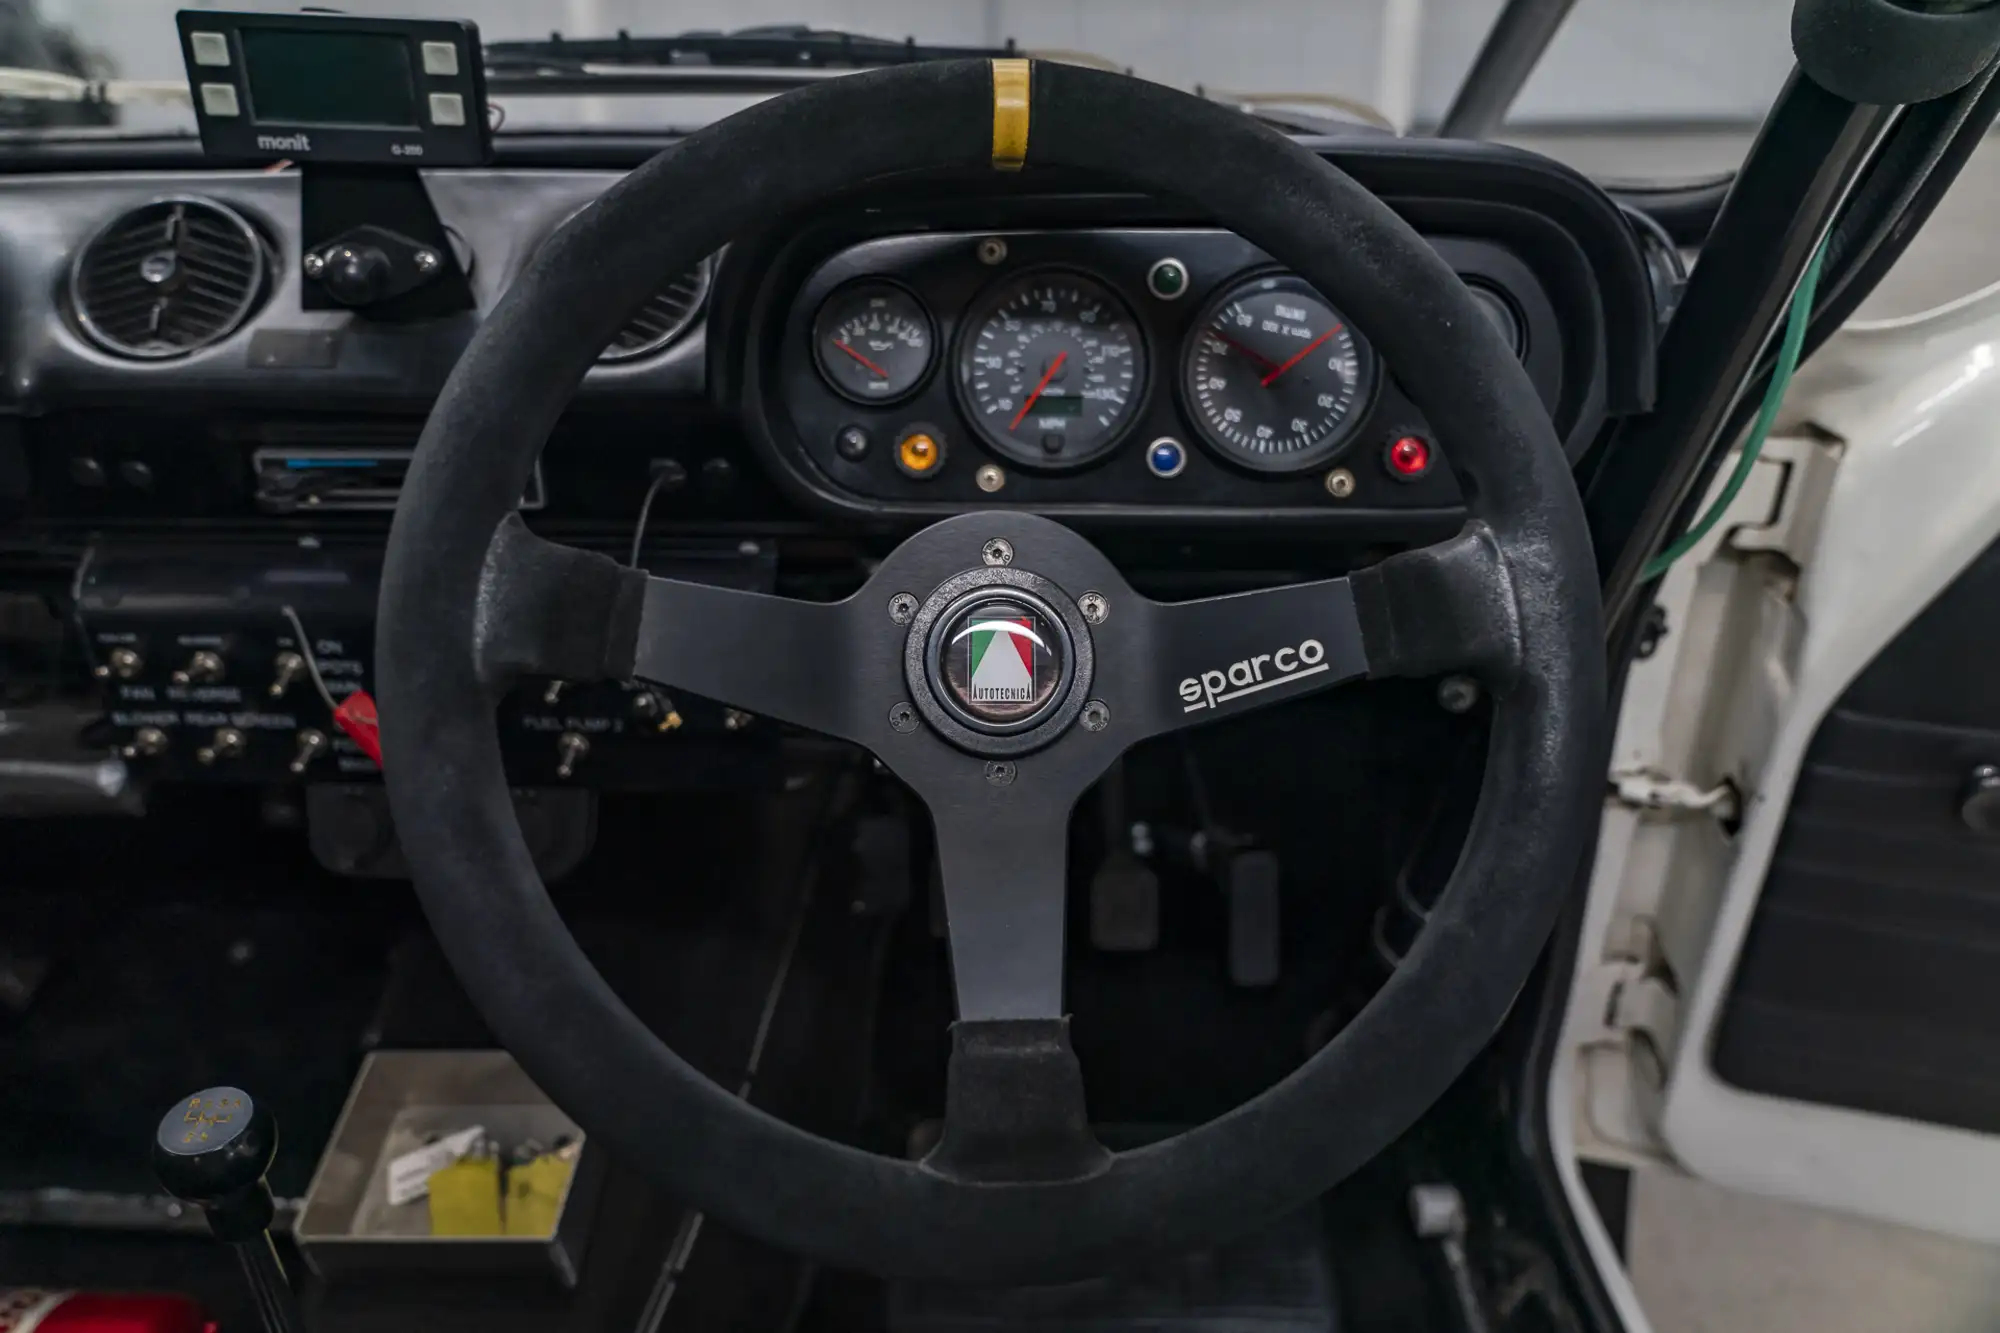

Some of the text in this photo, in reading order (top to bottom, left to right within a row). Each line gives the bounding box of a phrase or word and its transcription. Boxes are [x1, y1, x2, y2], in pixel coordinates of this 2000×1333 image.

[257, 134, 310, 151] monit
[1179, 639, 1325, 709] sparco
[973, 682, 1031, 700] AUTOTECNICA
